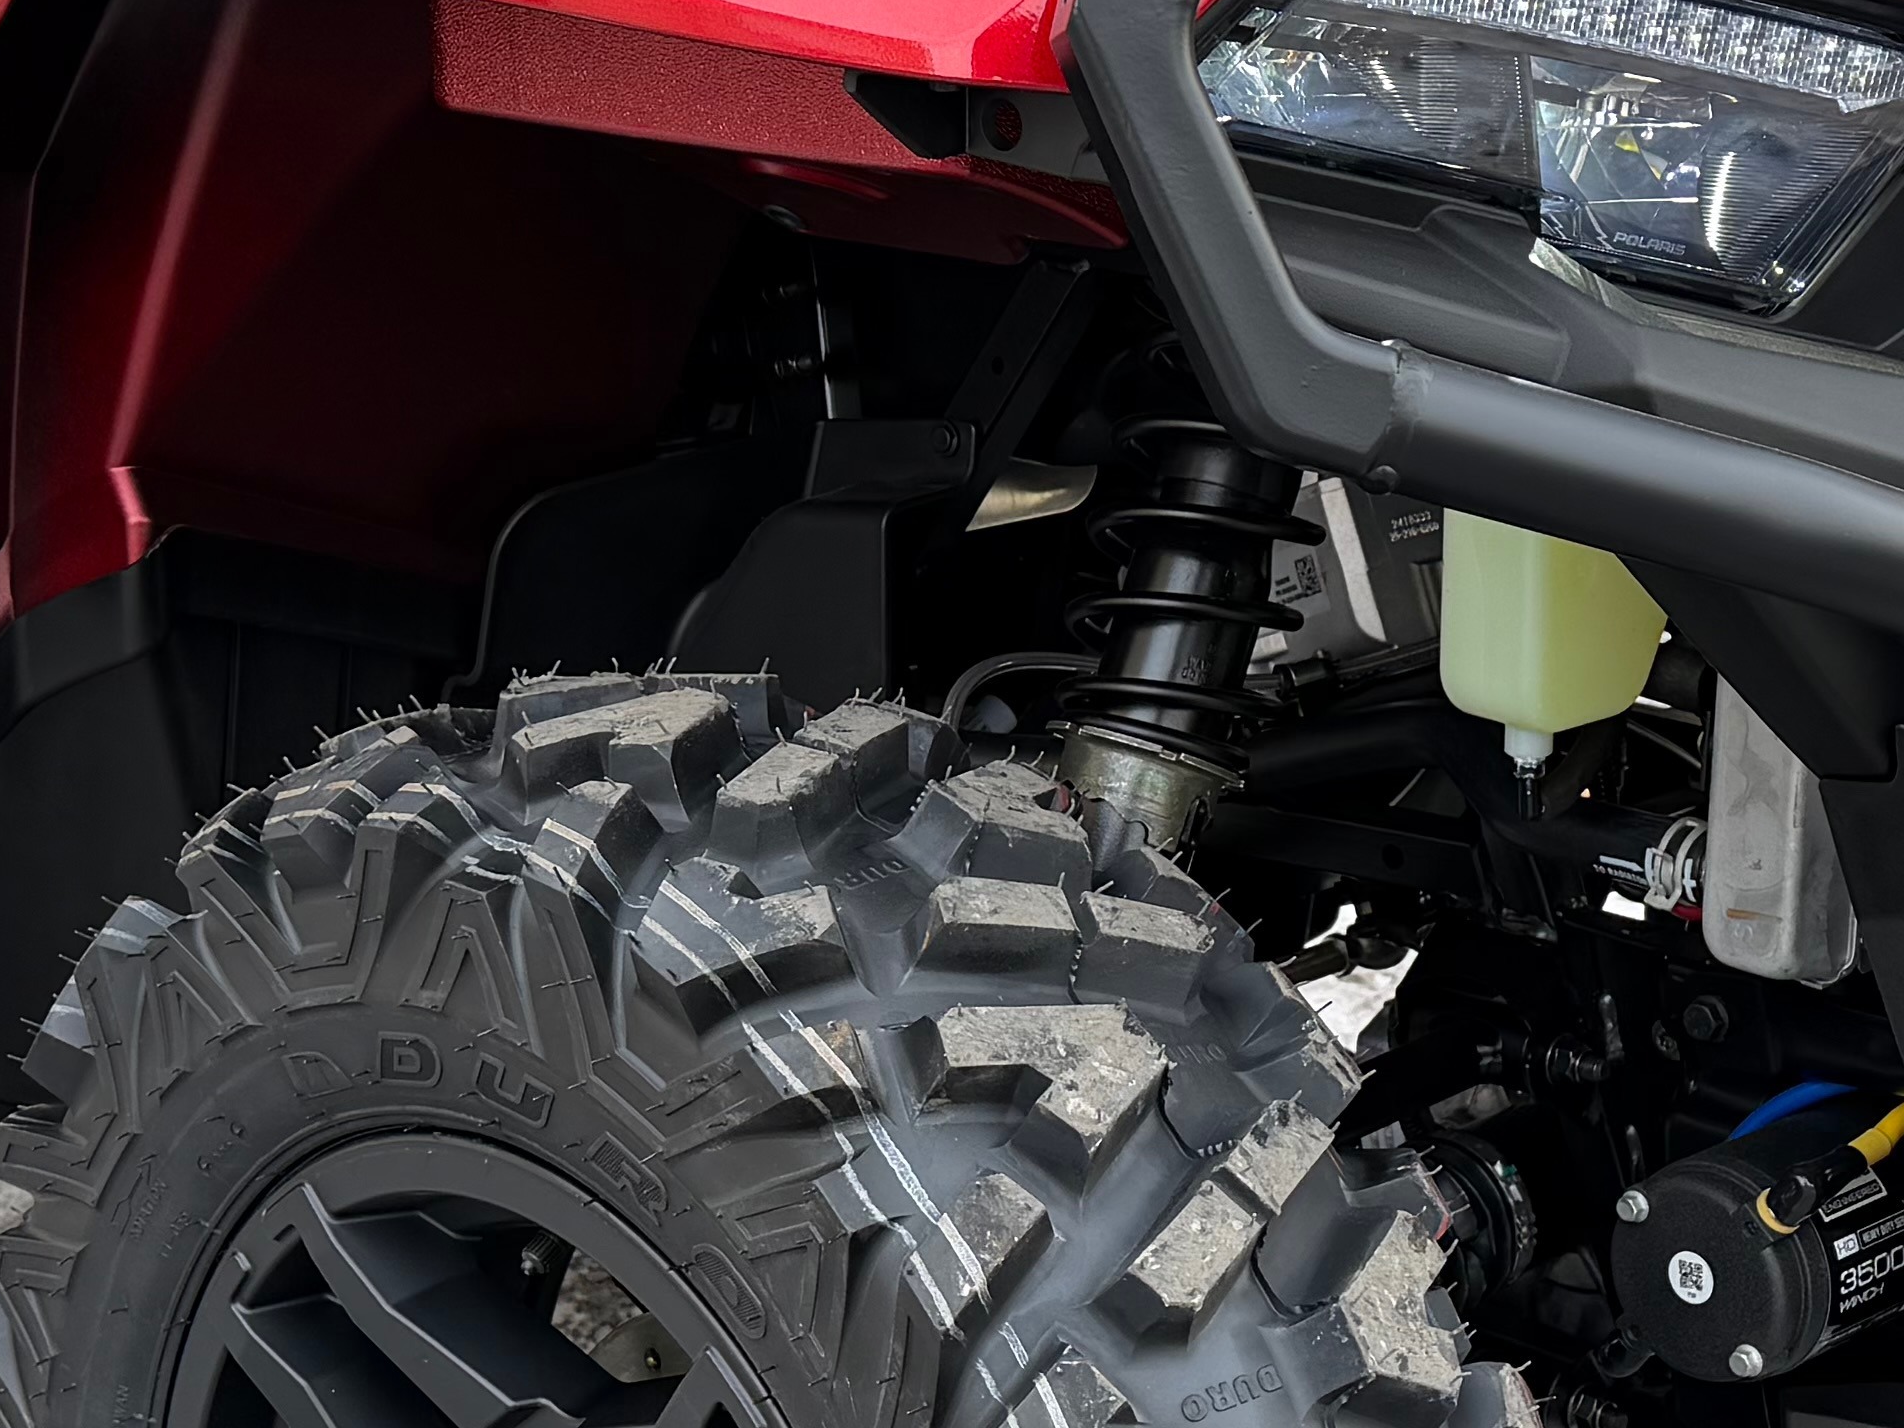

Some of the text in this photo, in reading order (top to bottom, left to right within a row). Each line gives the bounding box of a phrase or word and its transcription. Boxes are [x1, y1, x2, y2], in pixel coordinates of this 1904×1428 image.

[1612, 228, 1686, 257] POLARIS
[373, 1030, 765, 1338] DURO
[1836, 1237, 1857, 1255] HD
[1839, 1282, 1885, 1313] WINCH
[1182, 1365, 1283, 1423] DURO
